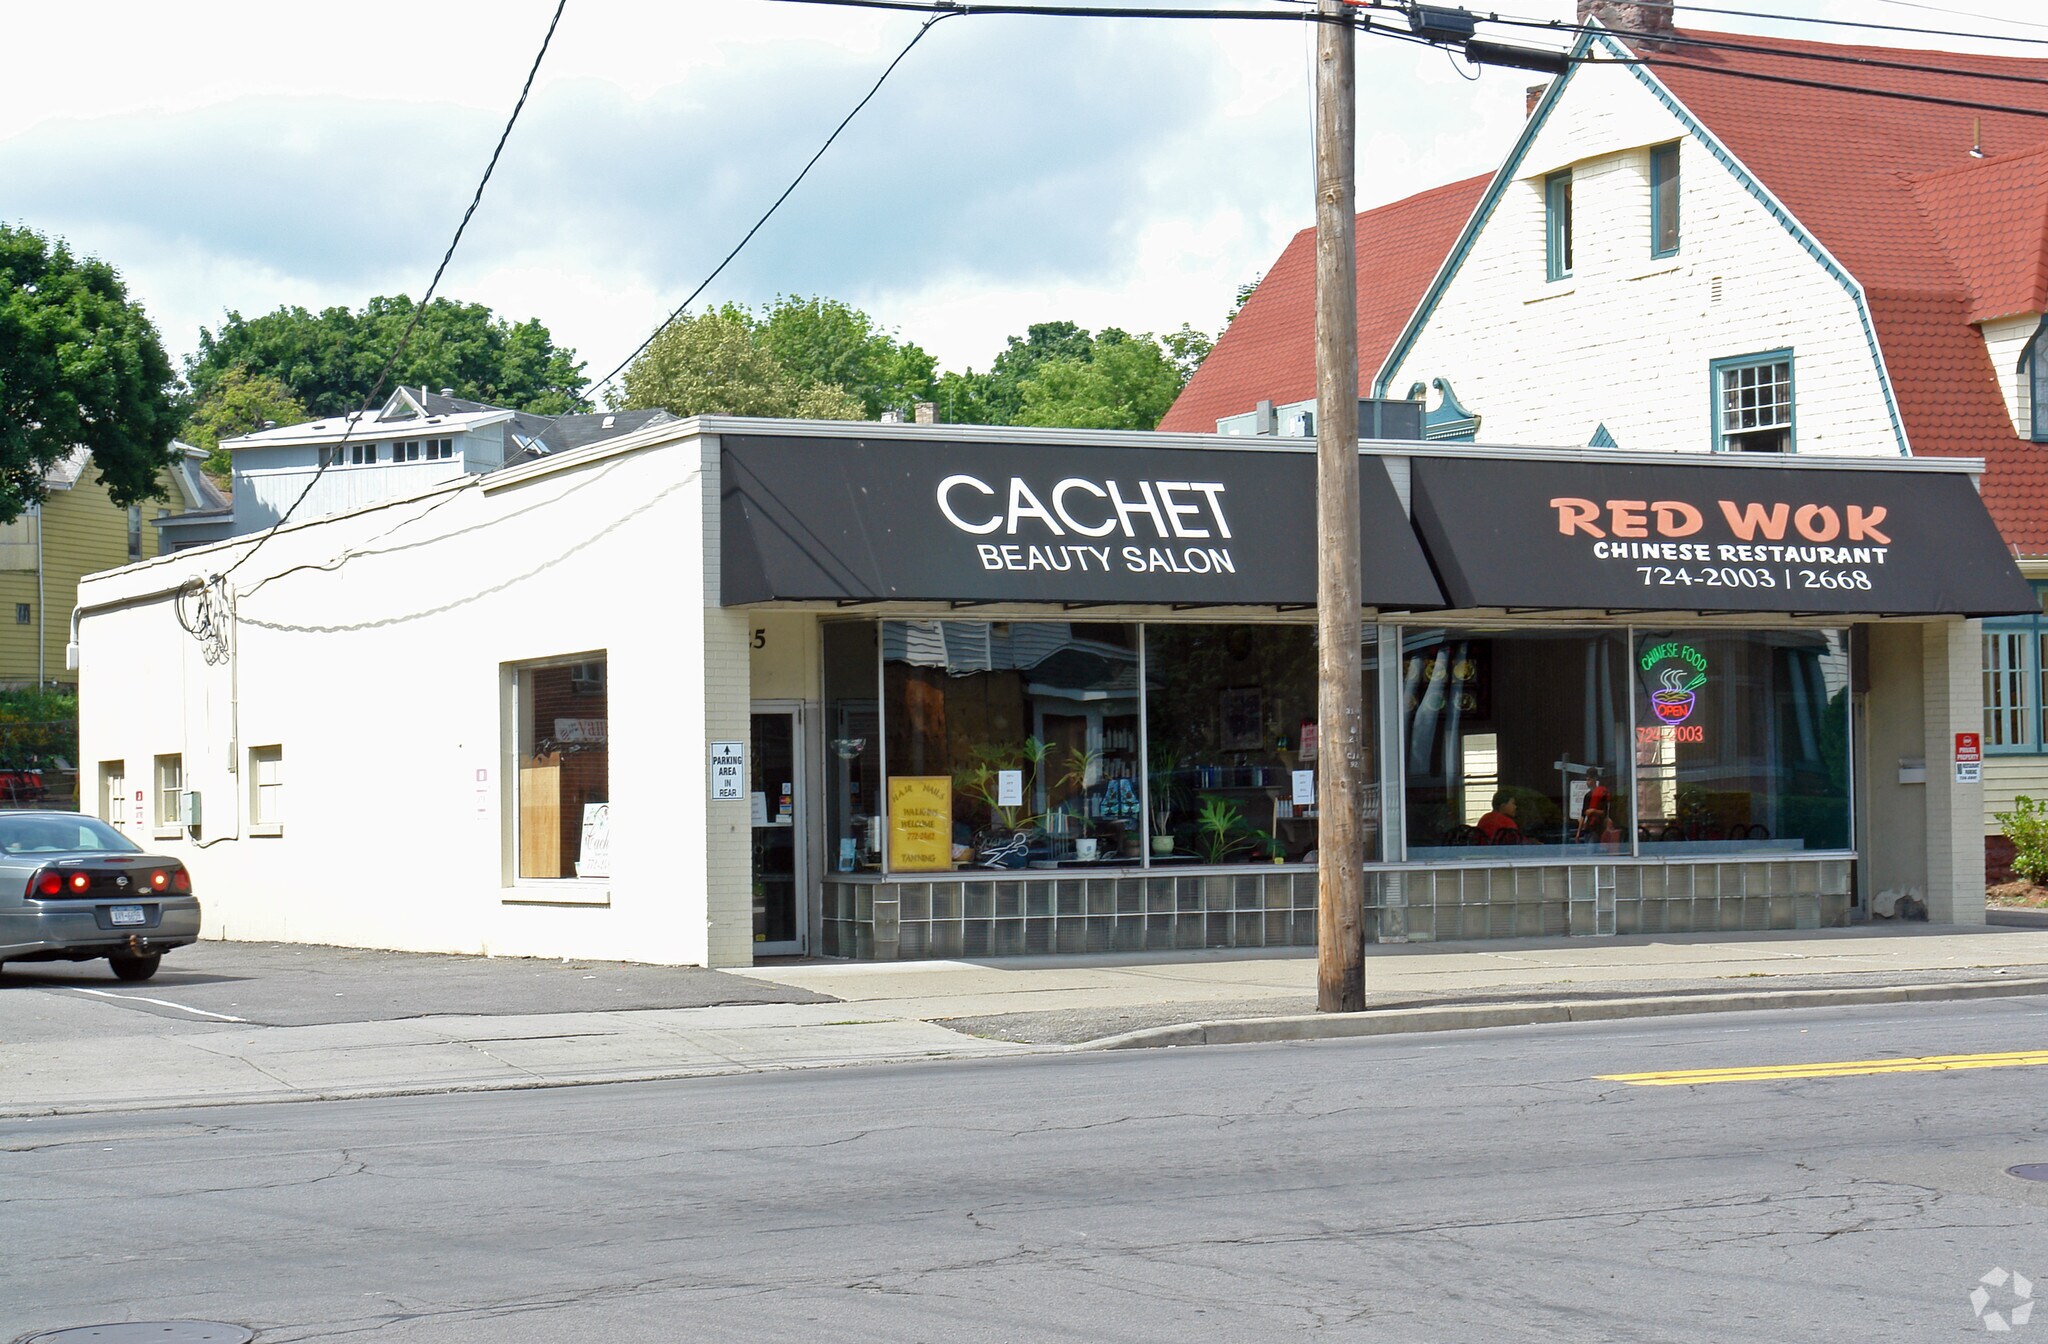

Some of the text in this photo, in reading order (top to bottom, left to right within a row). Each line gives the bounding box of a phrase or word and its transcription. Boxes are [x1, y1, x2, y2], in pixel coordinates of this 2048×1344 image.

[936, 474, 1232, 539] CACHET
[1550, 497, 1892, 545] RED WOK
[976, 544, 1236, 574] BEAUTY SALON
[1593, 541, 1888, 565] CHINESE RESTAURANT
[1636, 566, 1776, 588] 724-2003
[1799, 570, 1872, 591] 2668
[749, 628, 766, 649] 5
[1641, 642, 1708, 672] CHINESE FOOD
[1657, 704, 1688, 717] OPEN
[713, 756, 742, 765] PARKING
[718, 766, 737, 776] AREA
[724, 779, 731, 787] IN
[719, 788, 736, 797] REAR
[922, 784, 945, 800] NAILS
[901, 820, 935, 829] WELCOME
[901, 853, 937, 863] TANNING
